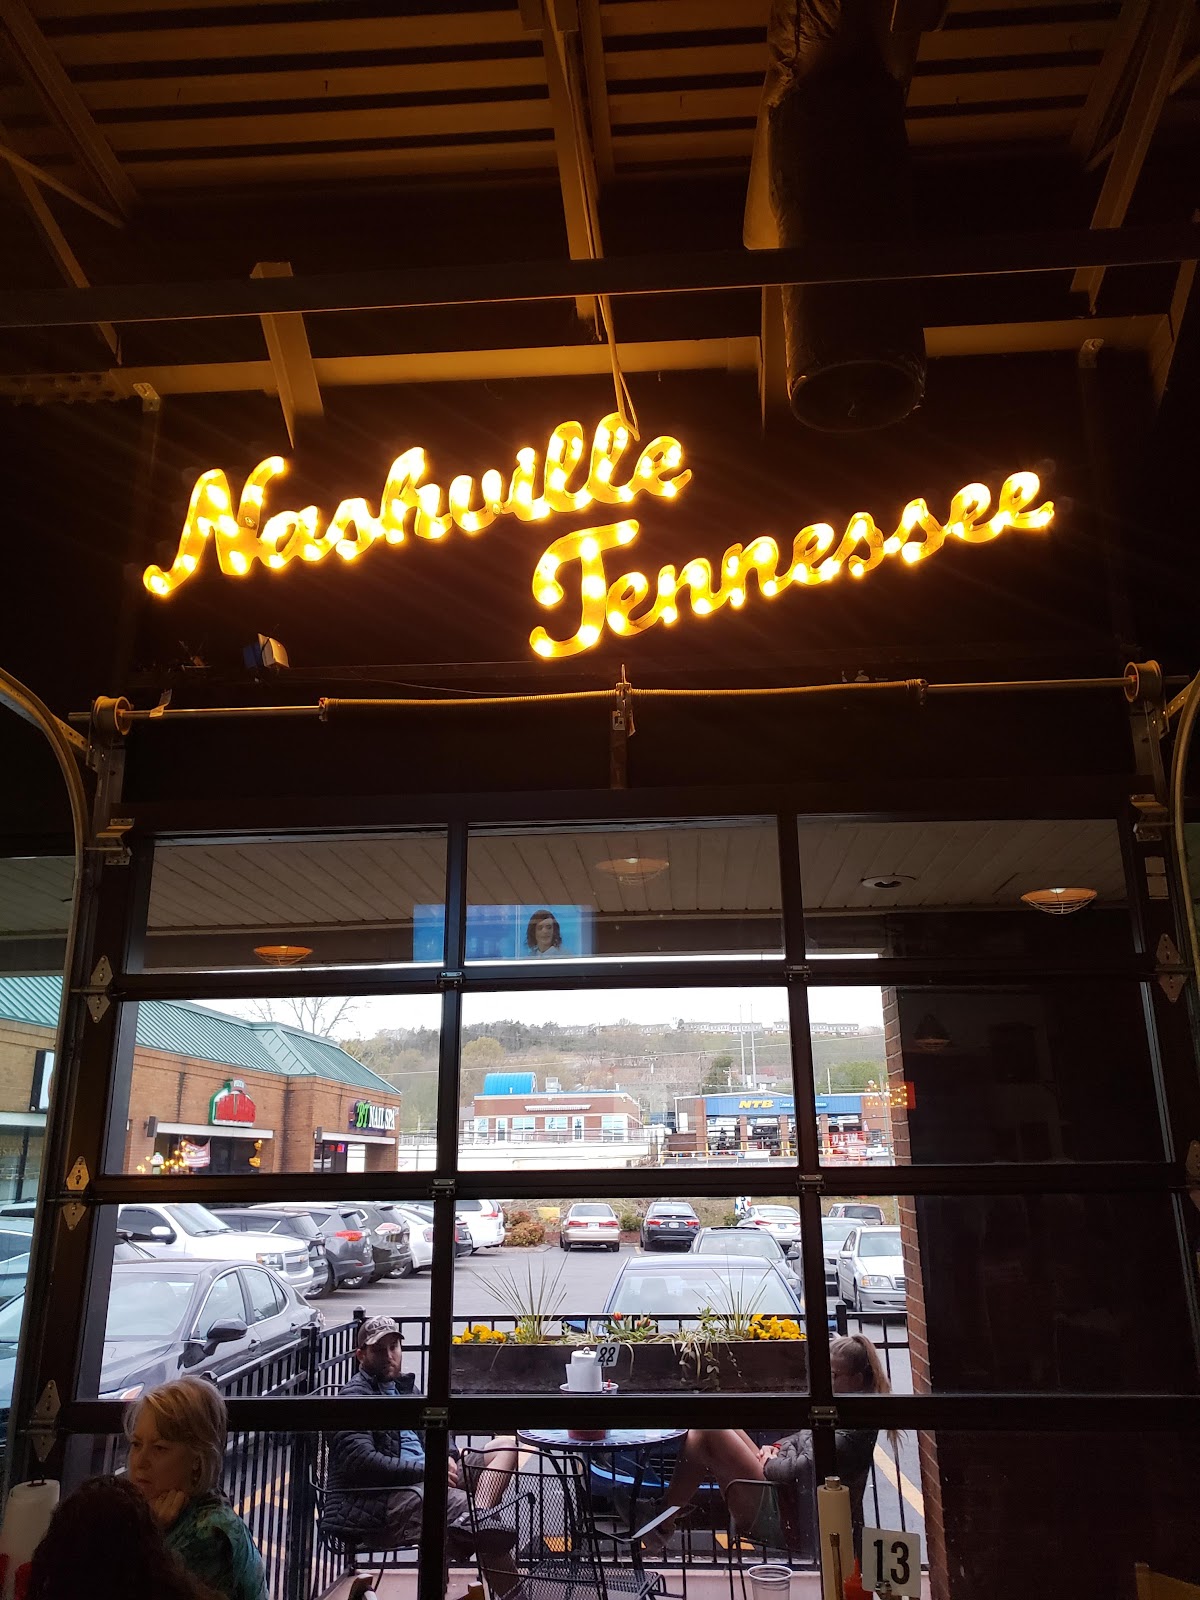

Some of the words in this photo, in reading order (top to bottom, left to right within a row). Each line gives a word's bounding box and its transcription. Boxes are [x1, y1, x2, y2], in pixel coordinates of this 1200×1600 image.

[142, 411, 692, 598] Nashville
[529, 470, 1056, 660] Tennessee
[369, 1105, 386, 1129] NAIL
[384, 1108, 396, 1130] SPA
[739, 1100, 774, 1109] NTB
[873, 1539, 910, 1585] 13
